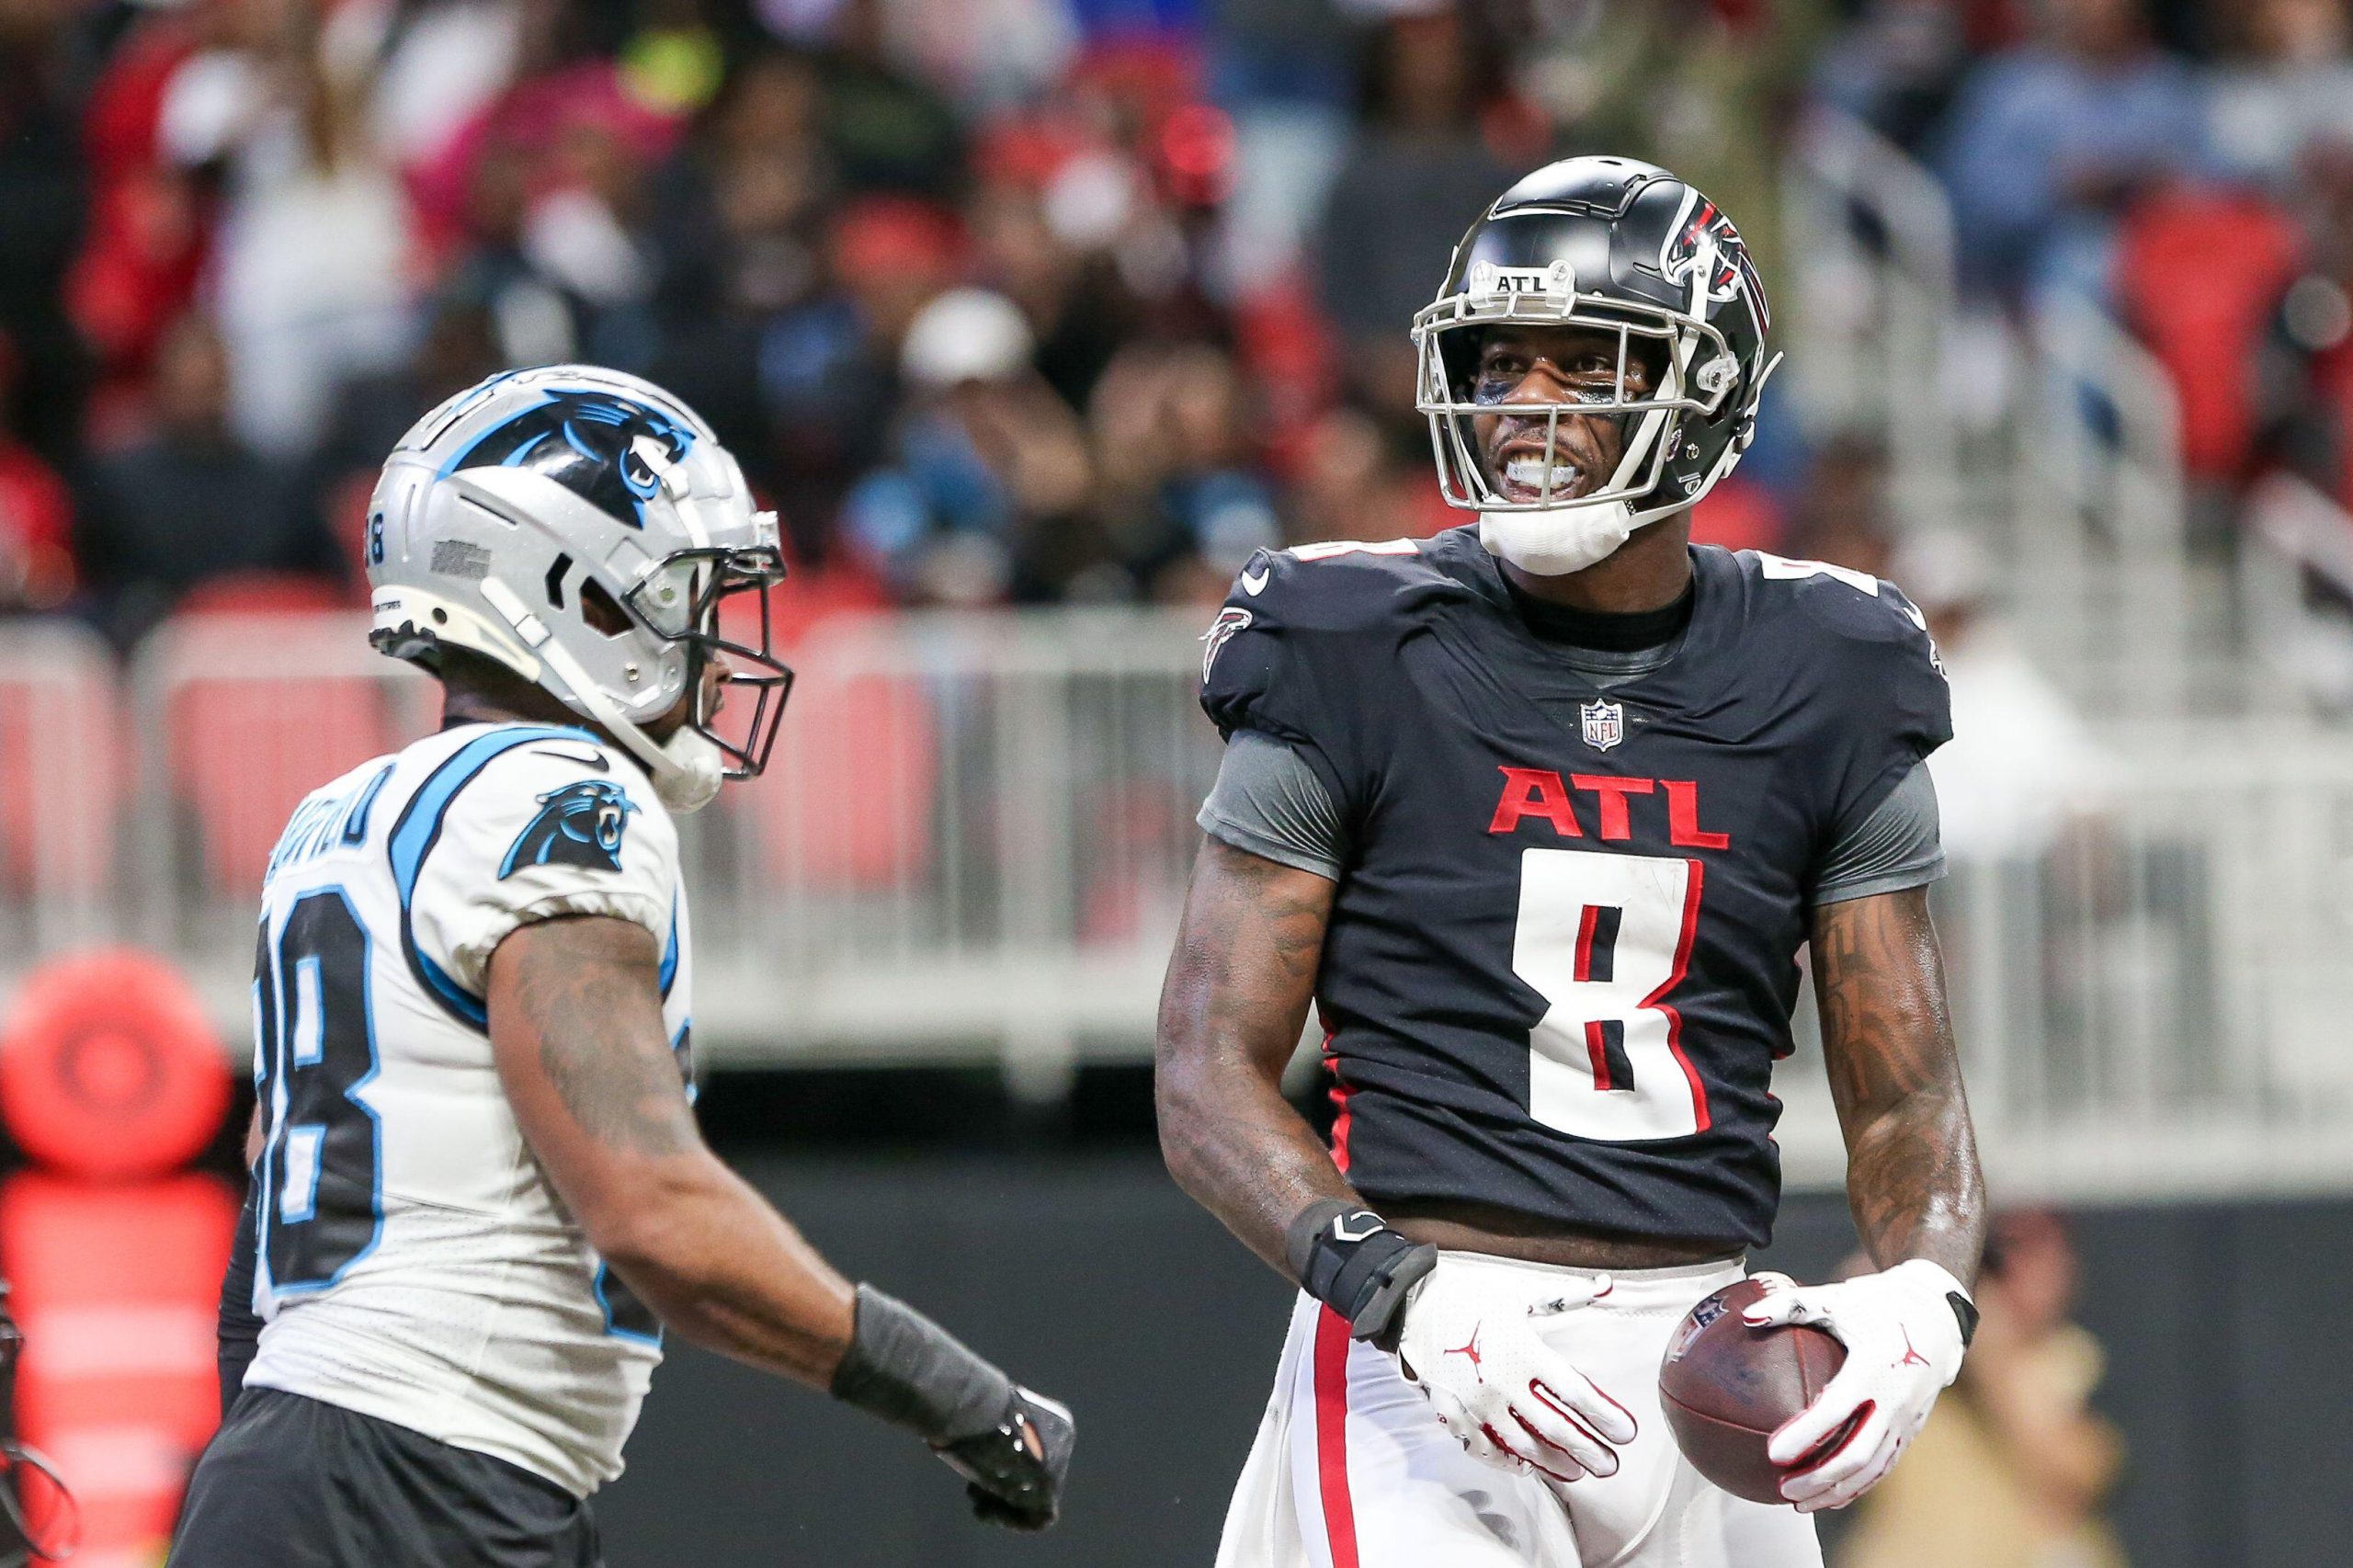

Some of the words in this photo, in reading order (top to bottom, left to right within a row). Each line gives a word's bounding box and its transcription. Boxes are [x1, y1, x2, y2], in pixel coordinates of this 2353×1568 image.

[1497, 276, 1547, 291] ATL
[1589, 722, 1617, 742] NFL
[1489, 766, 1730, 849] ATL
[1512, 847, 1711, 1142] 8
